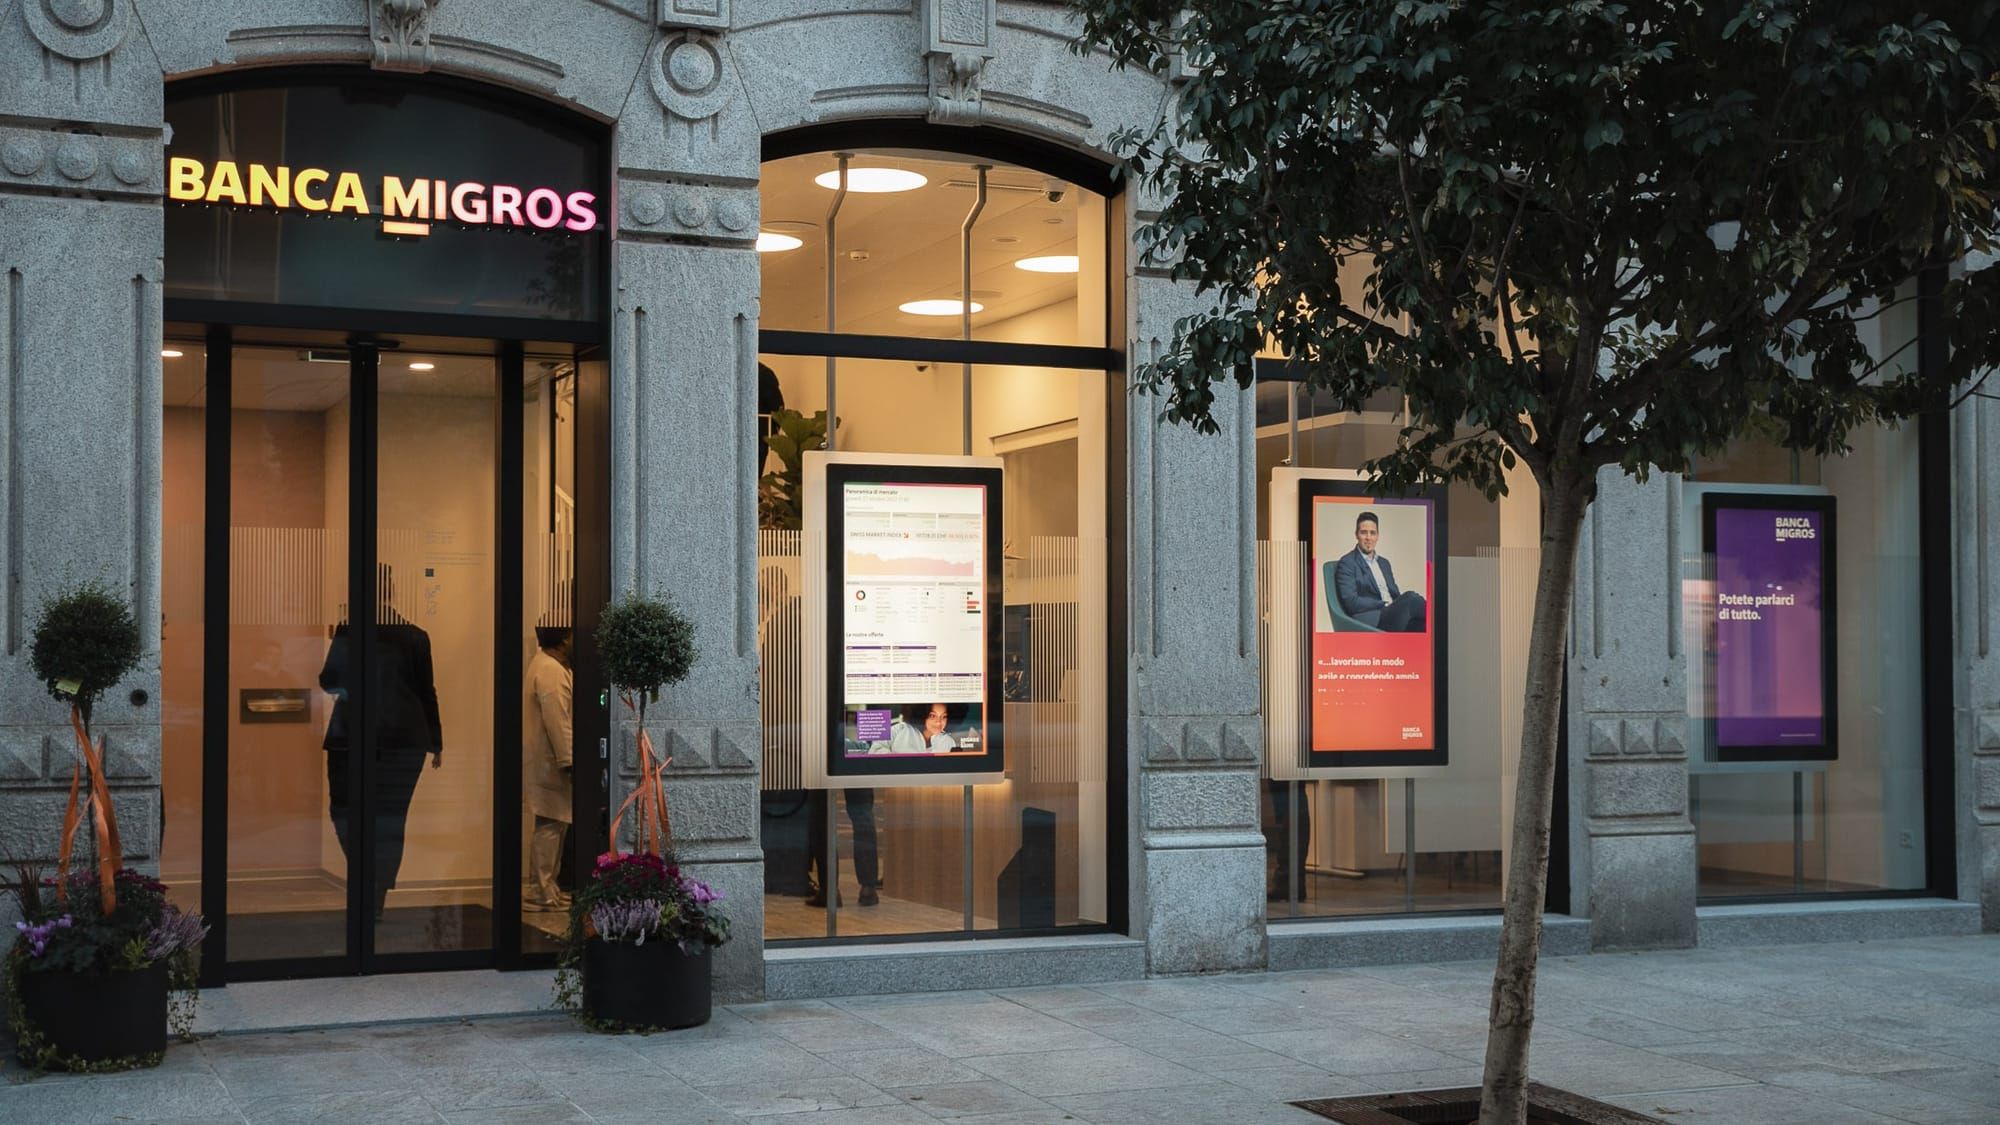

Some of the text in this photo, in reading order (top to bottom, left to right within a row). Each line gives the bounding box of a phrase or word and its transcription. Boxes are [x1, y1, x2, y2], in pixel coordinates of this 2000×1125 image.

[168, 156, 598, 234] BANCA MIGROS
[1775, 517, 1811, 528] BANCA
[1775, 528, 1816, 540] MIGROS
[1718, 593, 1795, 608] Potete parlarci
[1718, 607, 1762, 620] di tutto.
[1373, 657, 1381, 666] in
[1382, 657, 1405, 667] modo
